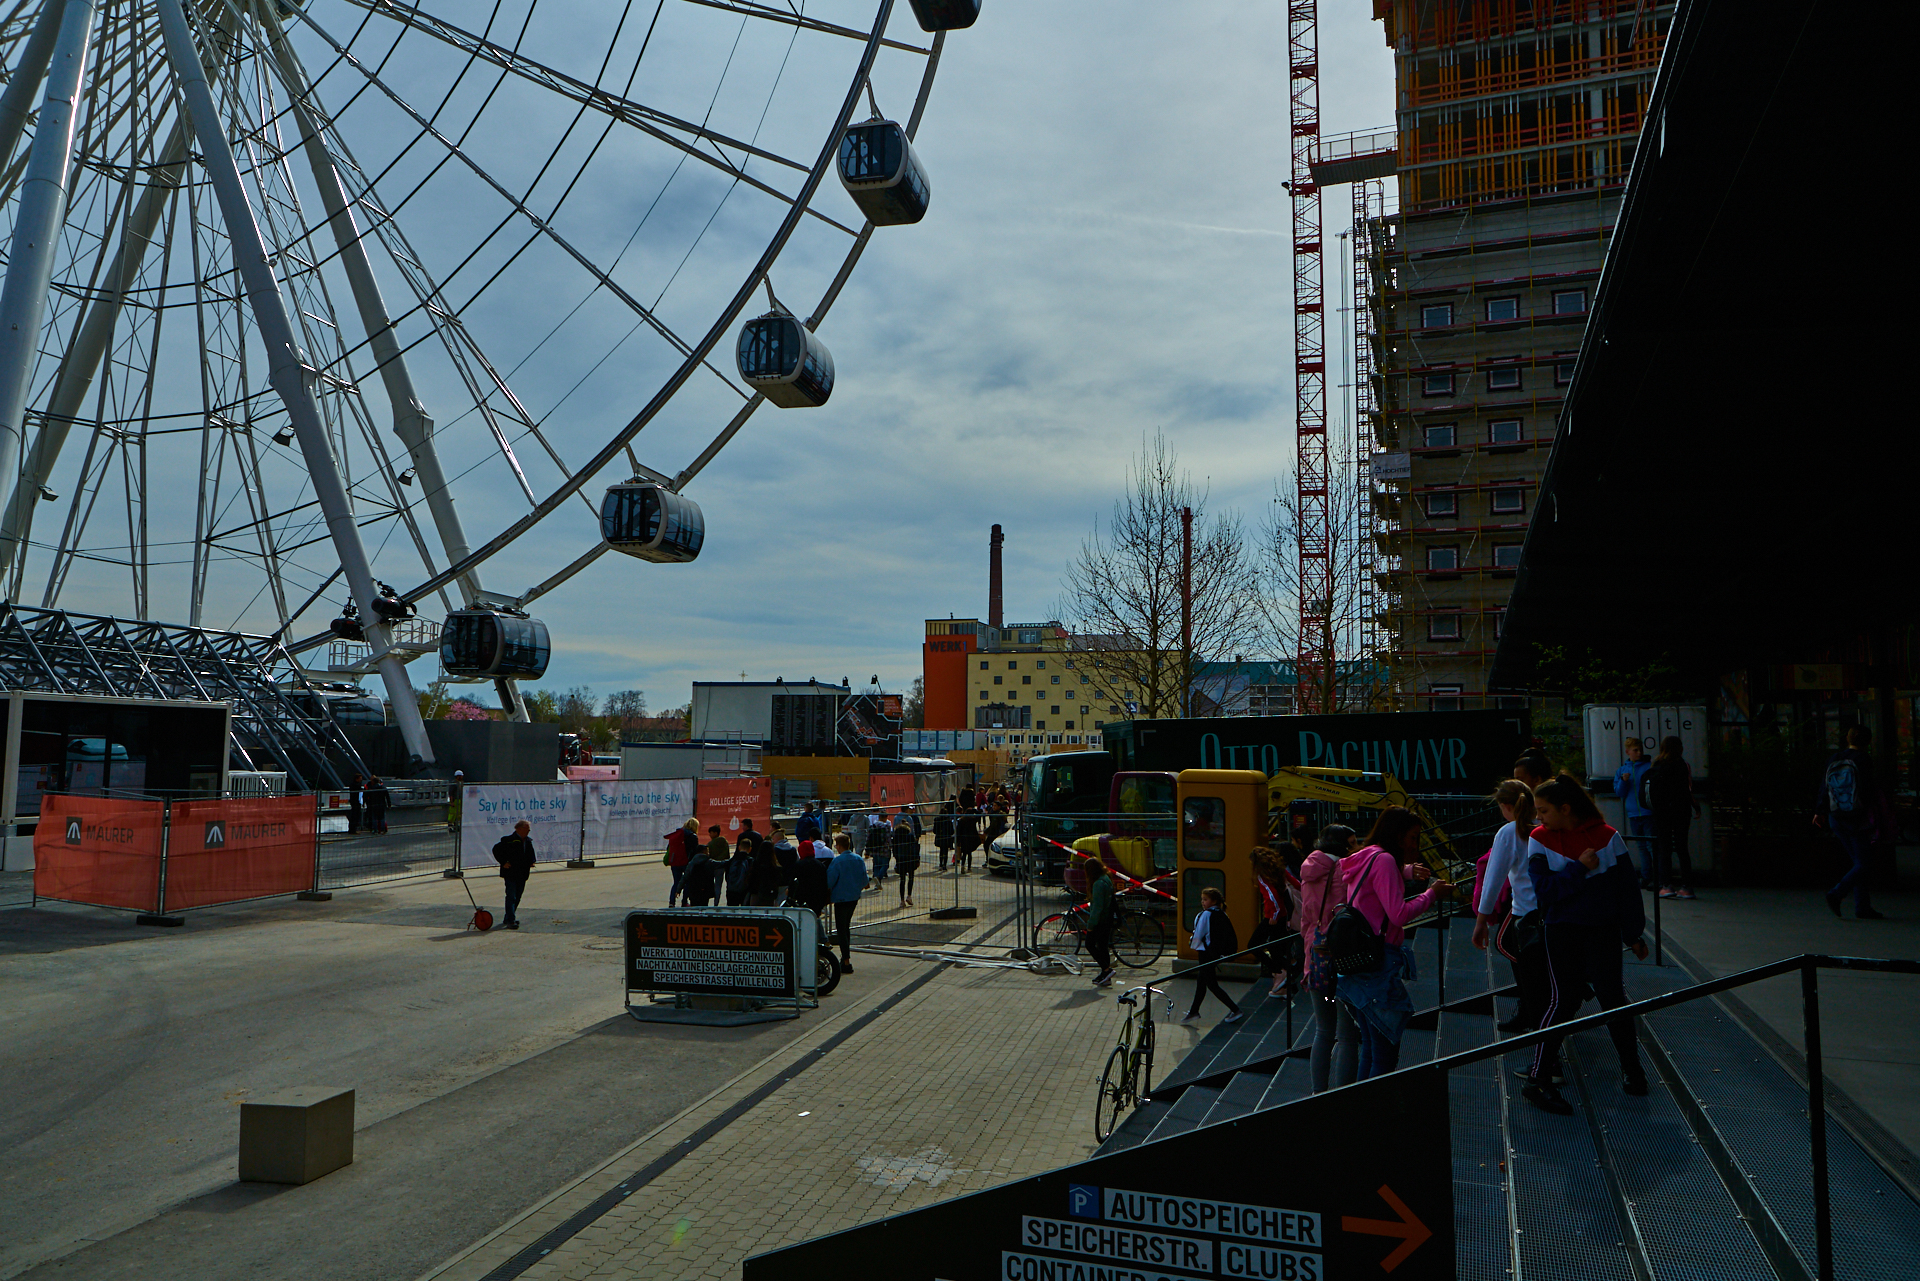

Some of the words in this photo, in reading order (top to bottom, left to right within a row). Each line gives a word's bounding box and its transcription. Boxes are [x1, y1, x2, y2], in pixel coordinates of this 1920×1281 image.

[929, 641, 967, 652] WERK1
[1603, 717, 1692, 730] white
[1200, 733, 1279, 773] OTTO
[1298, 730, 1468, 783] PACHMAYR
[479, 799, 498, 814] Say
[501, 798, 511, 811] hi
[515, 800, 526, 811] to
[529, 798, 546, 810] the
[549, 797, 567, 812] sky
[601, 794, 618, 807] Say
[621, 793, 631, 804] hi
[634, 794, 644, 805] to
[647, 792, 662, 804] the
[665, 791, 680, 804] sky
[710, 797, 735, 806] KOLLEGE
[735, 795, 760, 805] GESUCHT
[533, 815, 556, 824] gesucht
[87, 826, 134, 844] MAURER
[231, 822, 286, 840] MAURER
[669, 926, 757, 945] UMLEITUNG
[642, 948, 683, 959] WERK1-10
[686, 950, 729, 961] TONHALLE
[732, 952, 783, 963] TECHNIKUM
[637, 961, 702, 971] NACHTKANTINE
[705, 963, 783, 975] SCHLAGERGARTEN
[655, 973, 733, 986] SPEICHERSTRASSE
[736, 977, 784, 988] WILLENLOS
[1074, 1193, 1088, 1214] P
[1111, 1192, 1316, 1243] AUTOSPEICHER
[1027, 1220, 1208, 1269] SPEICHERSTR.
[1226, 1247, 1317, 1281] CLUBS
